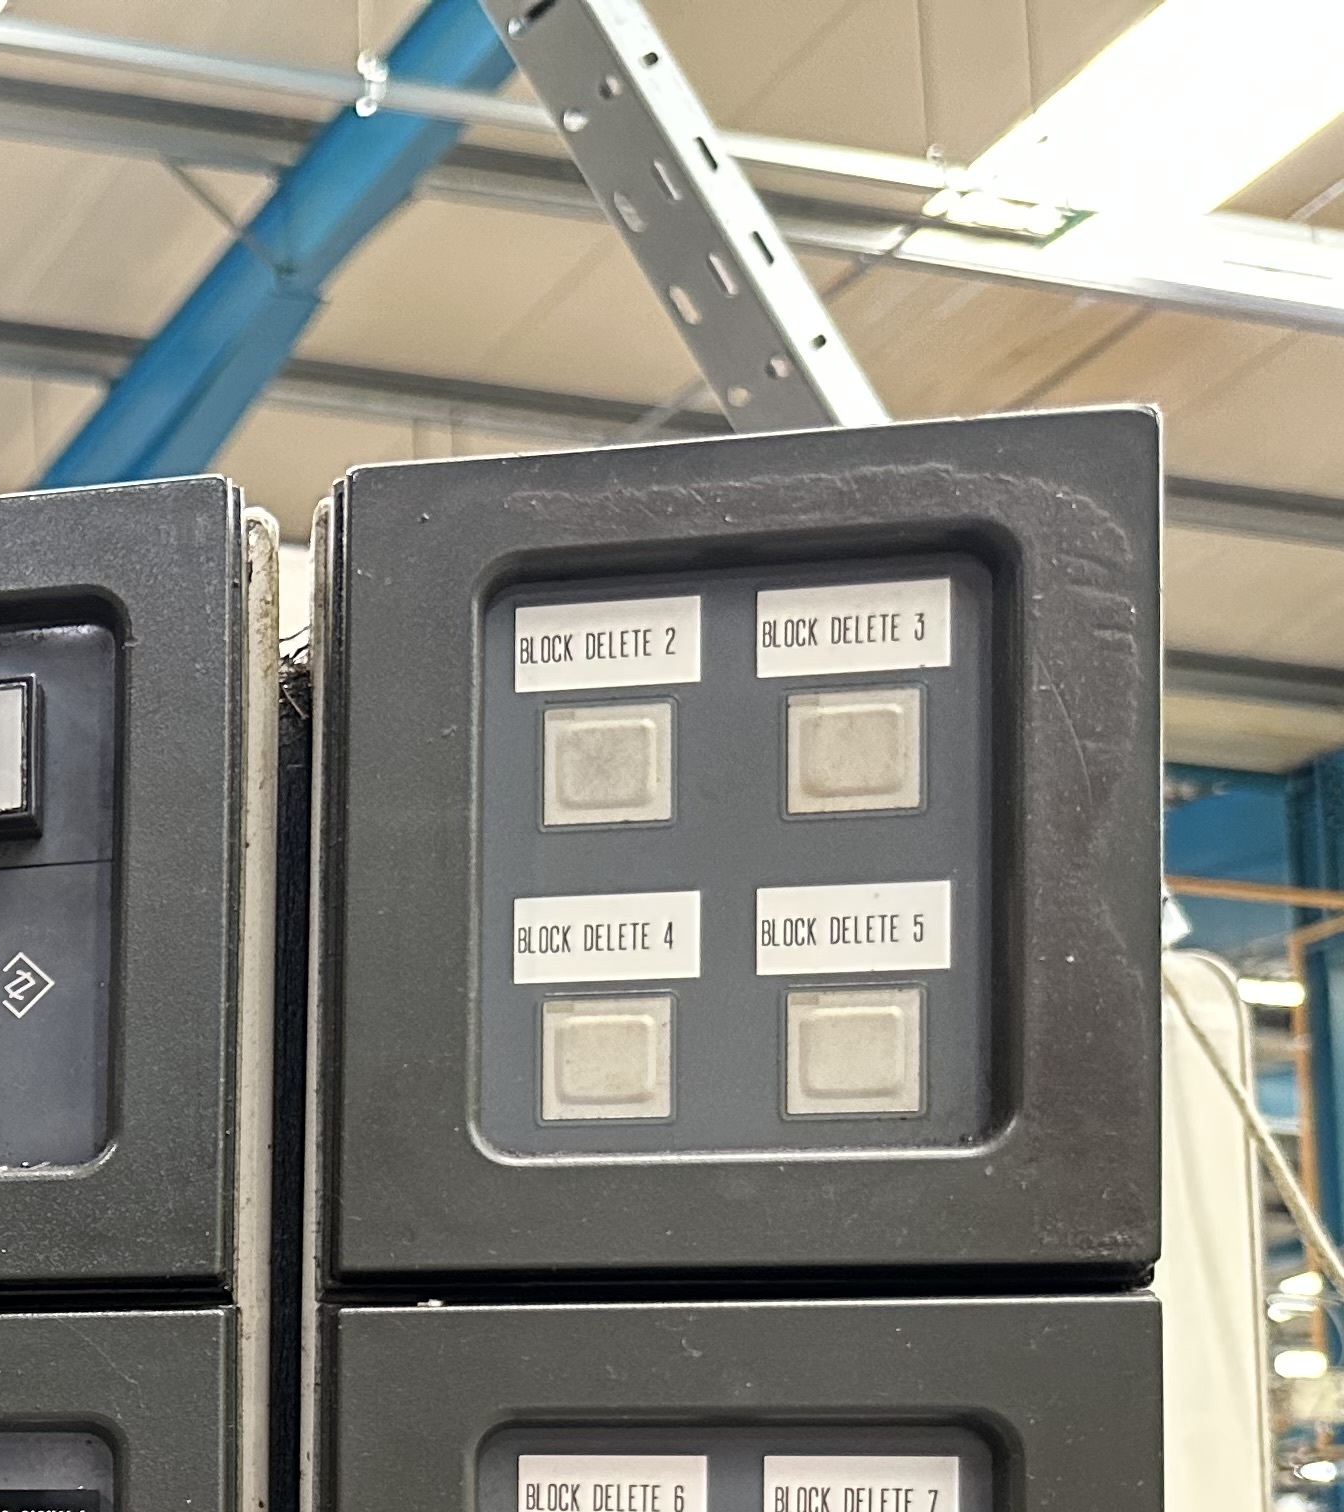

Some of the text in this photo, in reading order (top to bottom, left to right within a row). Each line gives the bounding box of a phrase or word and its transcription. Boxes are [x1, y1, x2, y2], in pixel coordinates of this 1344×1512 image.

[519, 627, 677, 665] BLOCK DELETE 2
[762, 612, 926, 648] BLOCK DELETE 3
[517, 922, 674, 954] BLOCK DELETE 4
[761, 915, 925, 946] BLOCK DELETE 5
[526, 1483, 685, 1512] BLOCK DELETE 6
